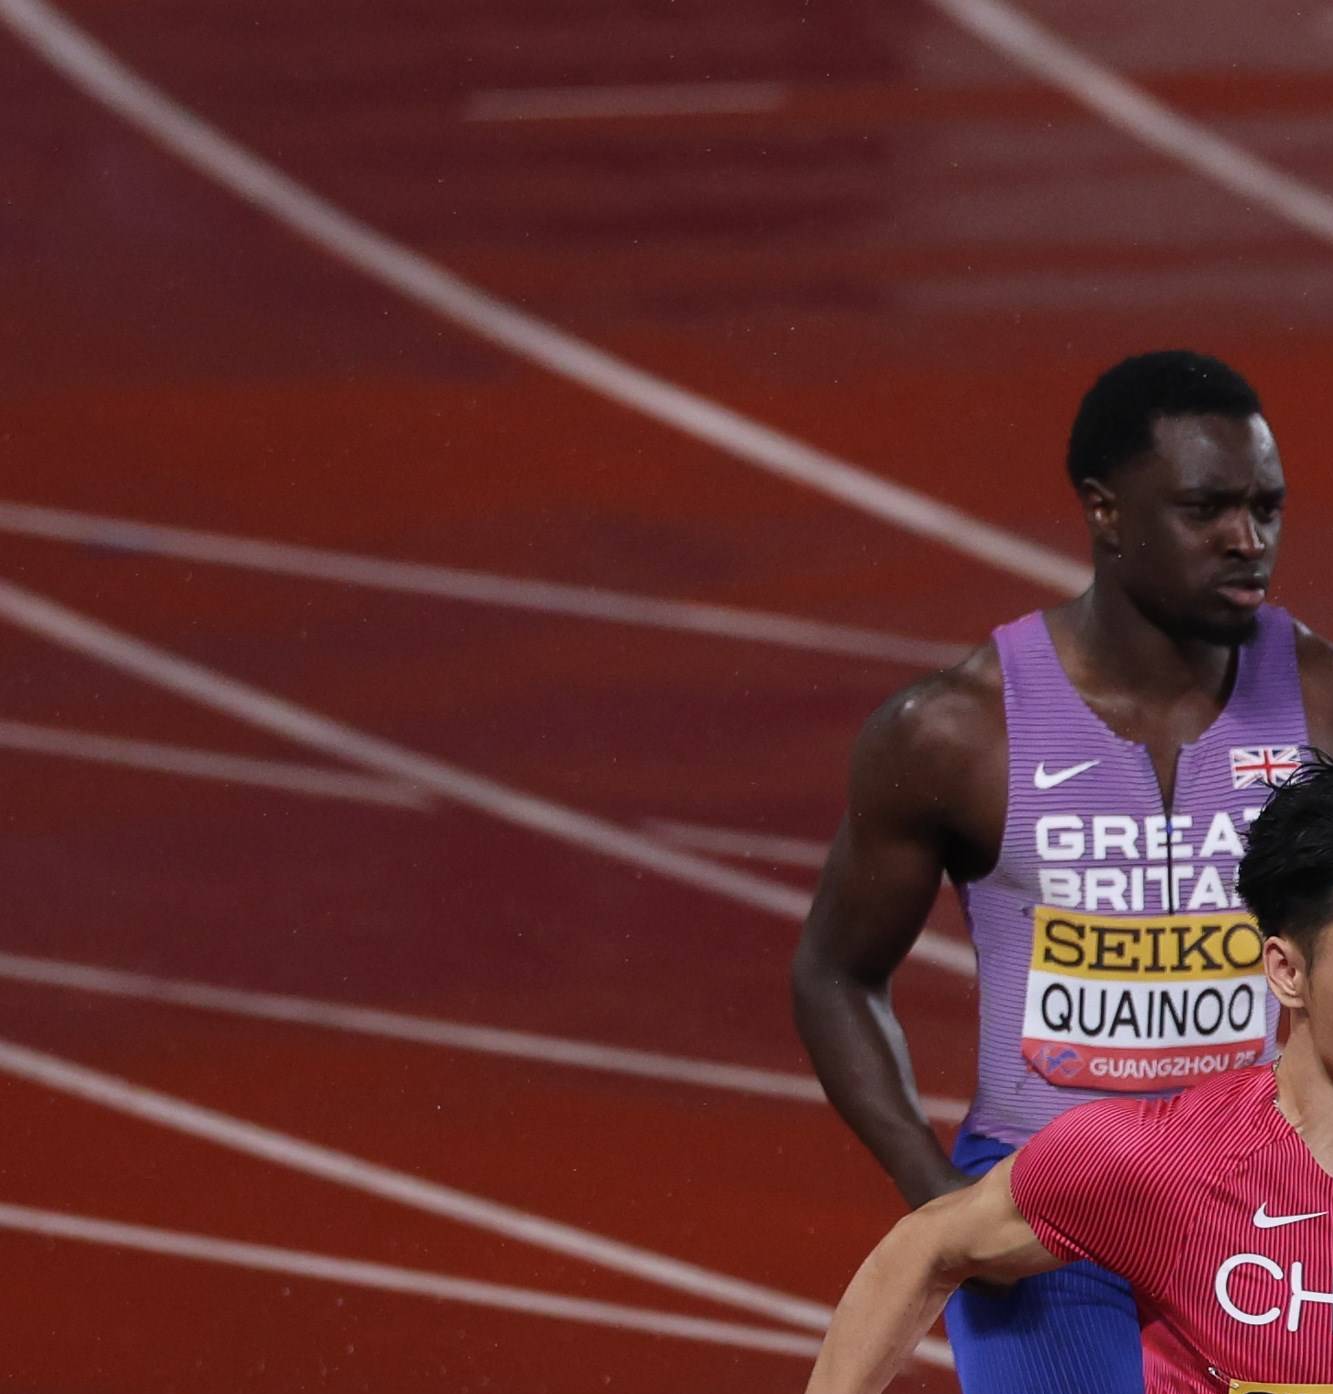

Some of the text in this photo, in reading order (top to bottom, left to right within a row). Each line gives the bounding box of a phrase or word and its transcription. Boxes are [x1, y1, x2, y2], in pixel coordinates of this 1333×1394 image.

[1039, 864, 1242, 912] BRITA
[1043, 918, 1263, 974] SEIKO
[1041, 982, 1254, 1039] QUAINOO
[1089, 1052, 1229, 1078] GUANGZHOU
